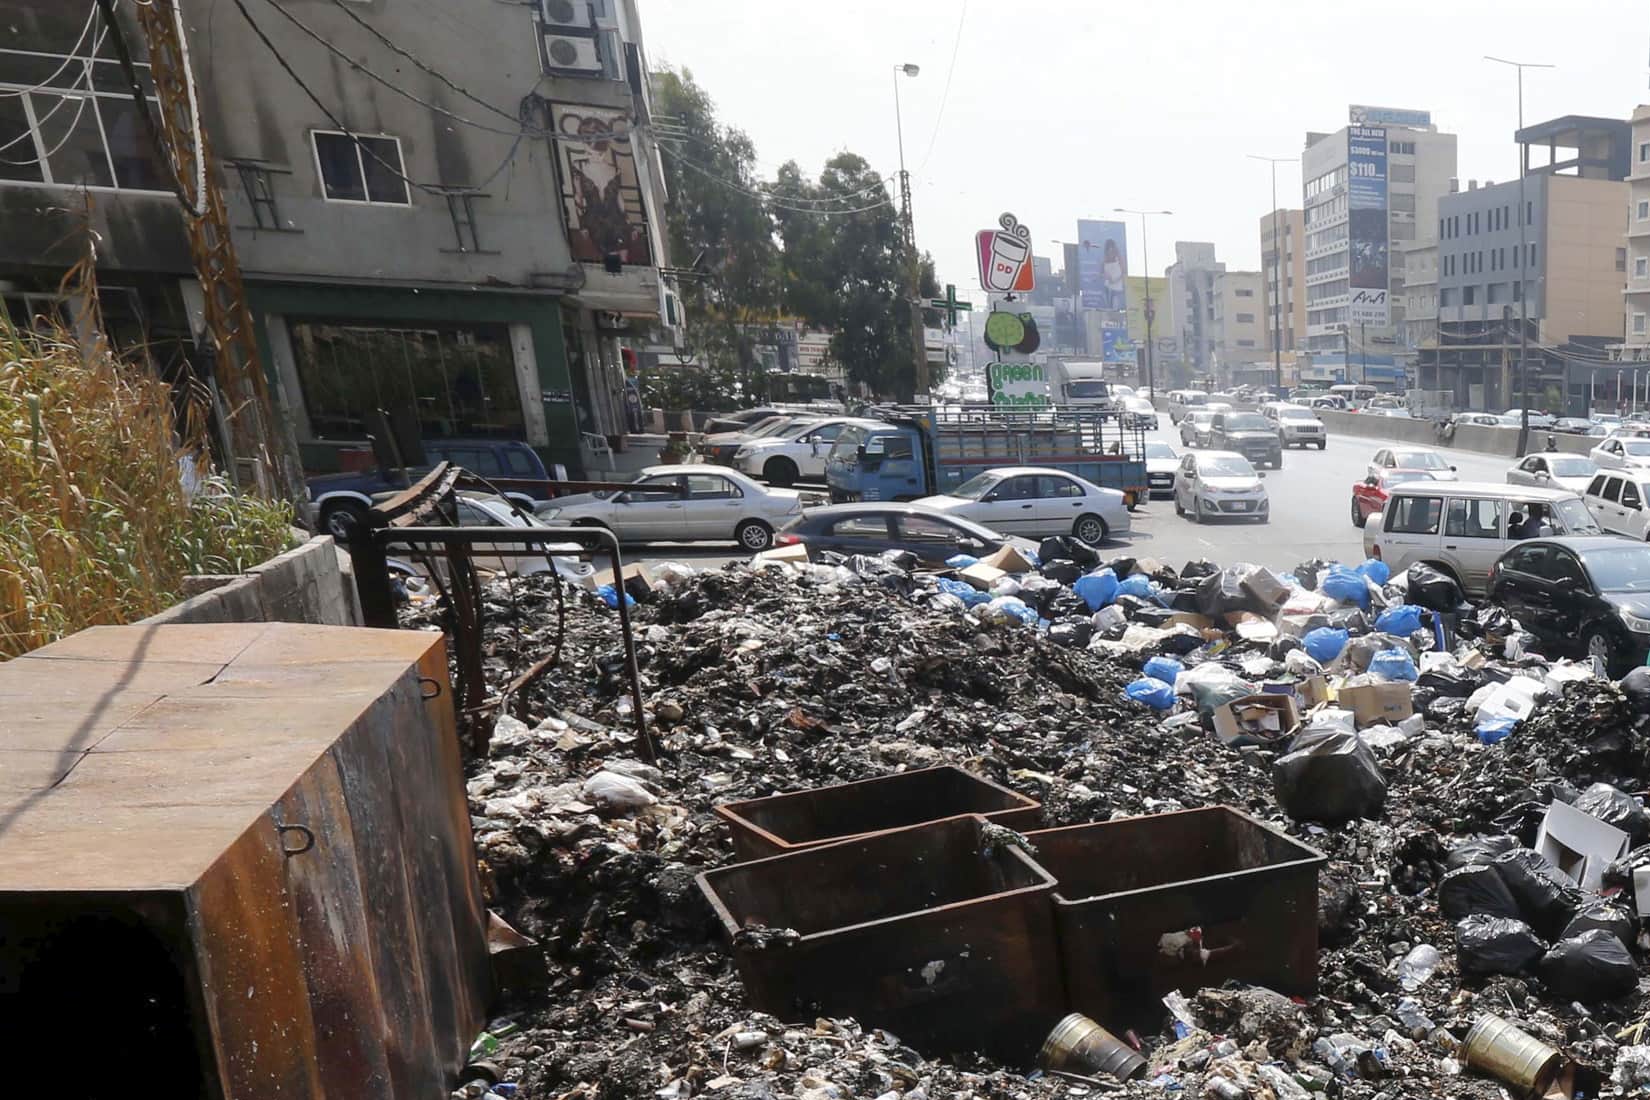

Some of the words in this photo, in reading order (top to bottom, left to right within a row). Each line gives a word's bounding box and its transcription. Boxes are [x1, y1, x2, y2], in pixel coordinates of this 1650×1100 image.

[1350, 161, 1376, 177] $110
[996, 262, 1013, 275] DD
[992, 363, 1044, 390] green
